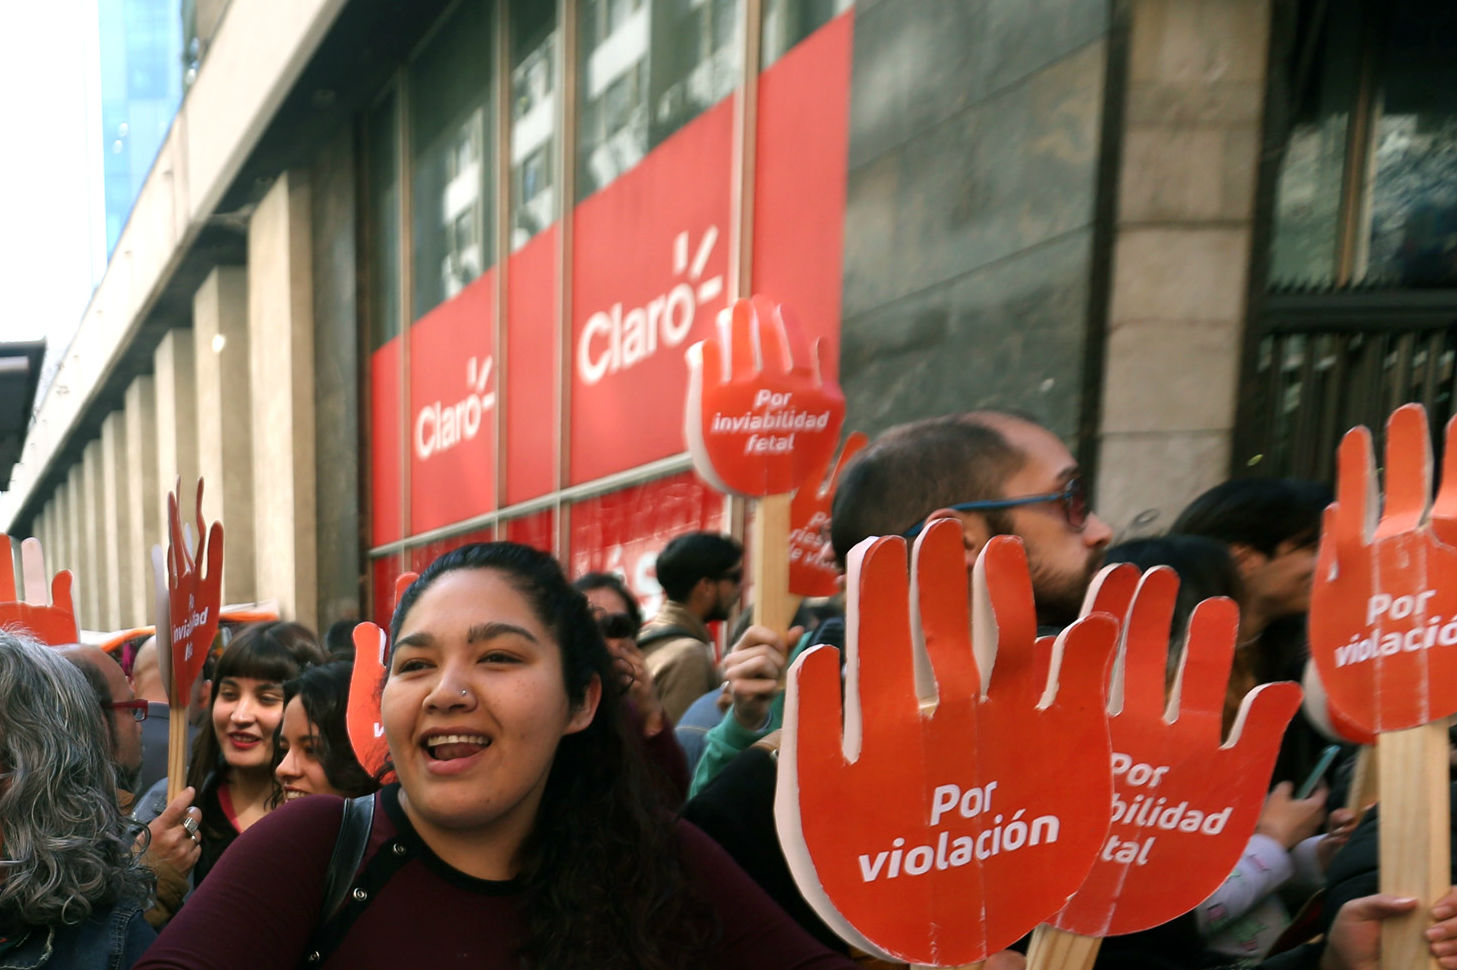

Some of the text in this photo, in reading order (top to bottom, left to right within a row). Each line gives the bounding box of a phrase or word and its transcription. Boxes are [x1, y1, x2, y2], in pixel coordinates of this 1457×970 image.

[577, 283, 696, 387] Claro
[754, 388, 793, 409] Por
[415, 394, 482, 461] Claro
[711, 410, 831, 433] inviabilidad
[746, 434, 795, 453] fetal
[1366, 589, 1437, 627] Por
[1111, 752, 1170, 788] Por
[930, 781, 998, 827] Por
[858, 808, 1061, 883] violación
